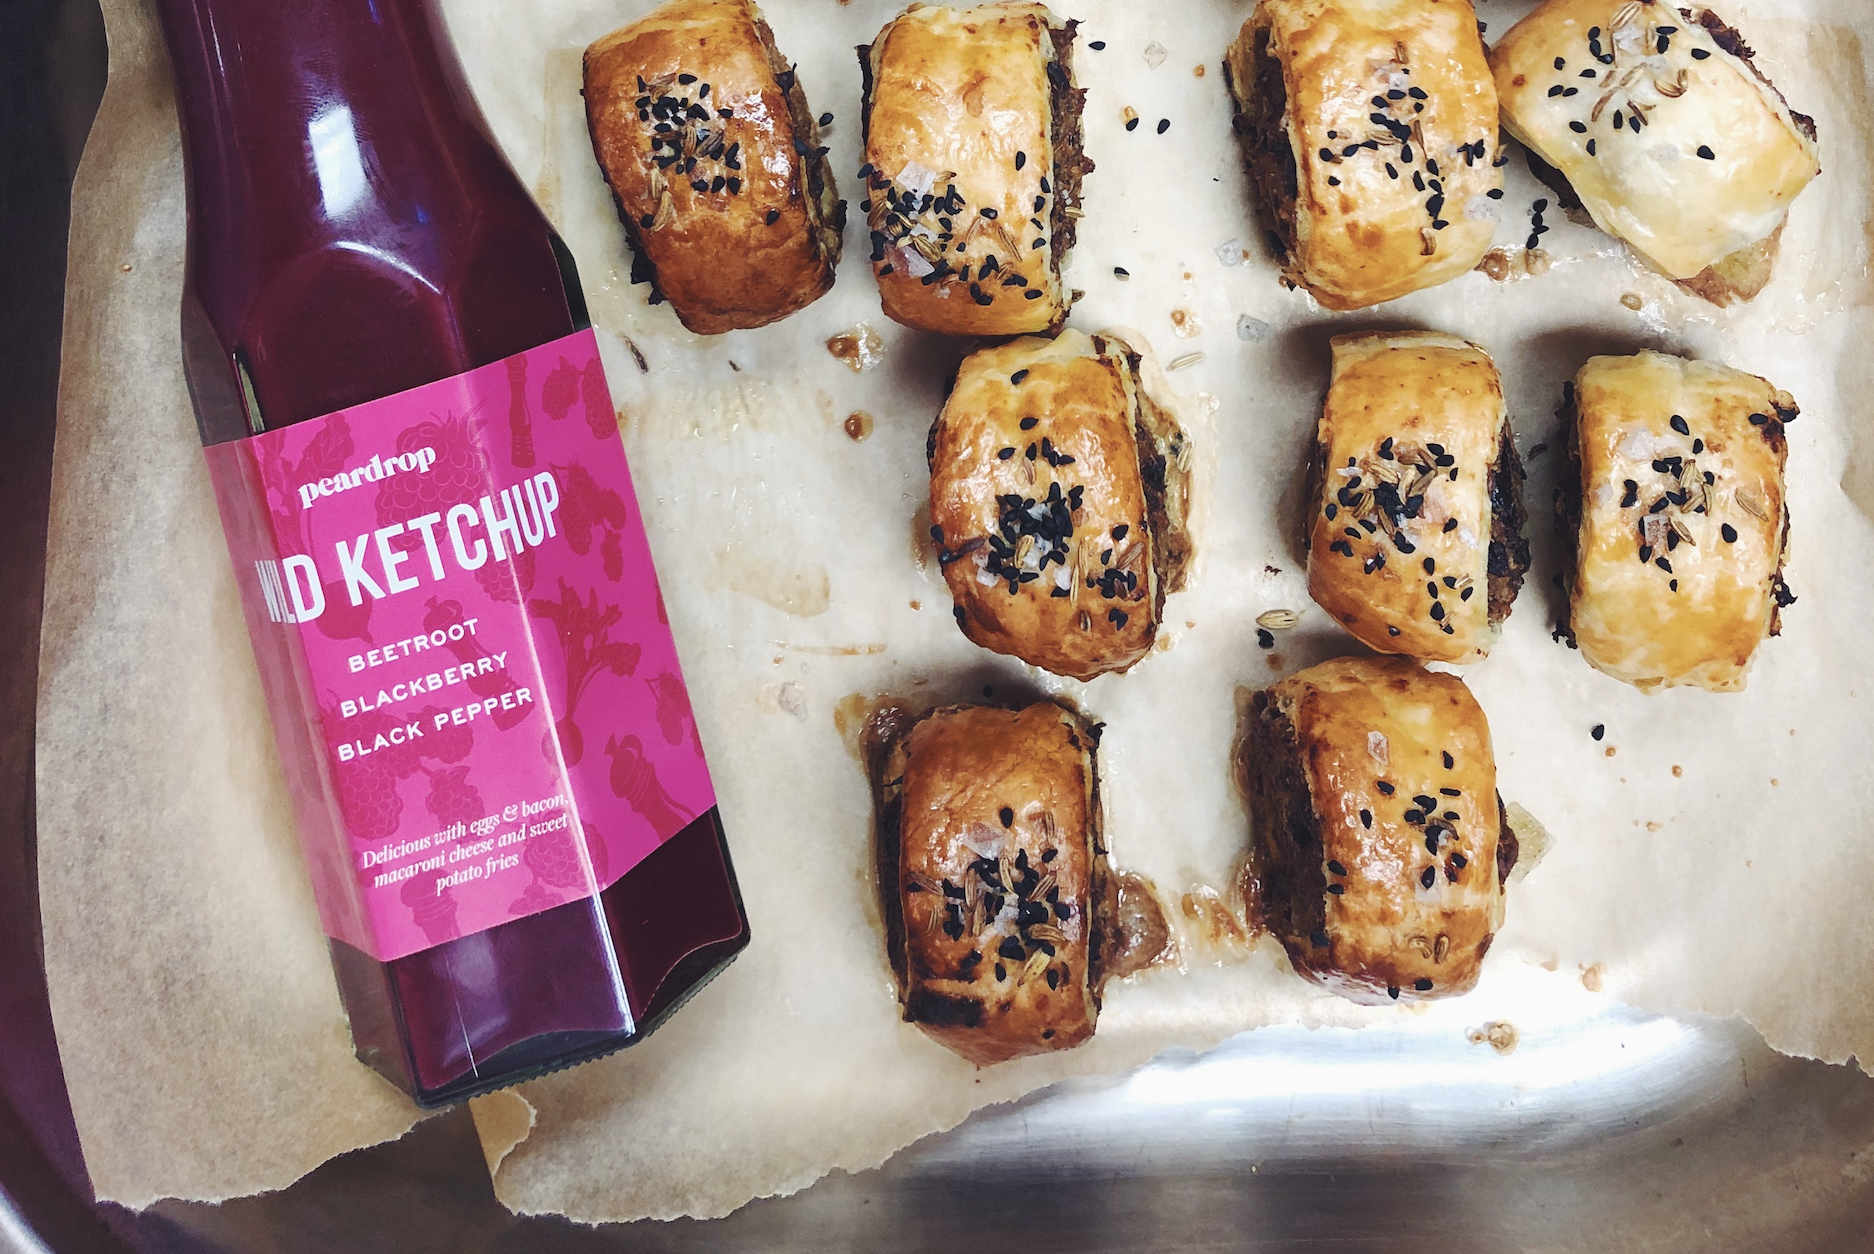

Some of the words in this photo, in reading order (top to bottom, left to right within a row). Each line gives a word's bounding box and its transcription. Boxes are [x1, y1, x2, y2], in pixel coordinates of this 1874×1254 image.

[298, 446, 437, 509] peardrop
[335, 471, 560, 607] KETCHUP
[348, 618, 478, 673] BEETROOT
[340, 651, 508, 718] BLACKBERRY
[337, 721, 424, 761] BLACK
[433, 687, 533, 731] PEPPER
[362, 836, 432, 869] Delicious
[433, 820, 467, 845] with
[469, 813, 501, 836] eggs
[502, 803, 519, 821] &
[521, 793, 569, 818] bacon,
[374, 851, 447, 888] macaroni
[448, 840, 495, 865] cheese
[498, 822, 527, 848] and
[529, 811, 569, 836] sweet
[435, 866, 484, 896] potato
[483, 852, 520, 879] fries
